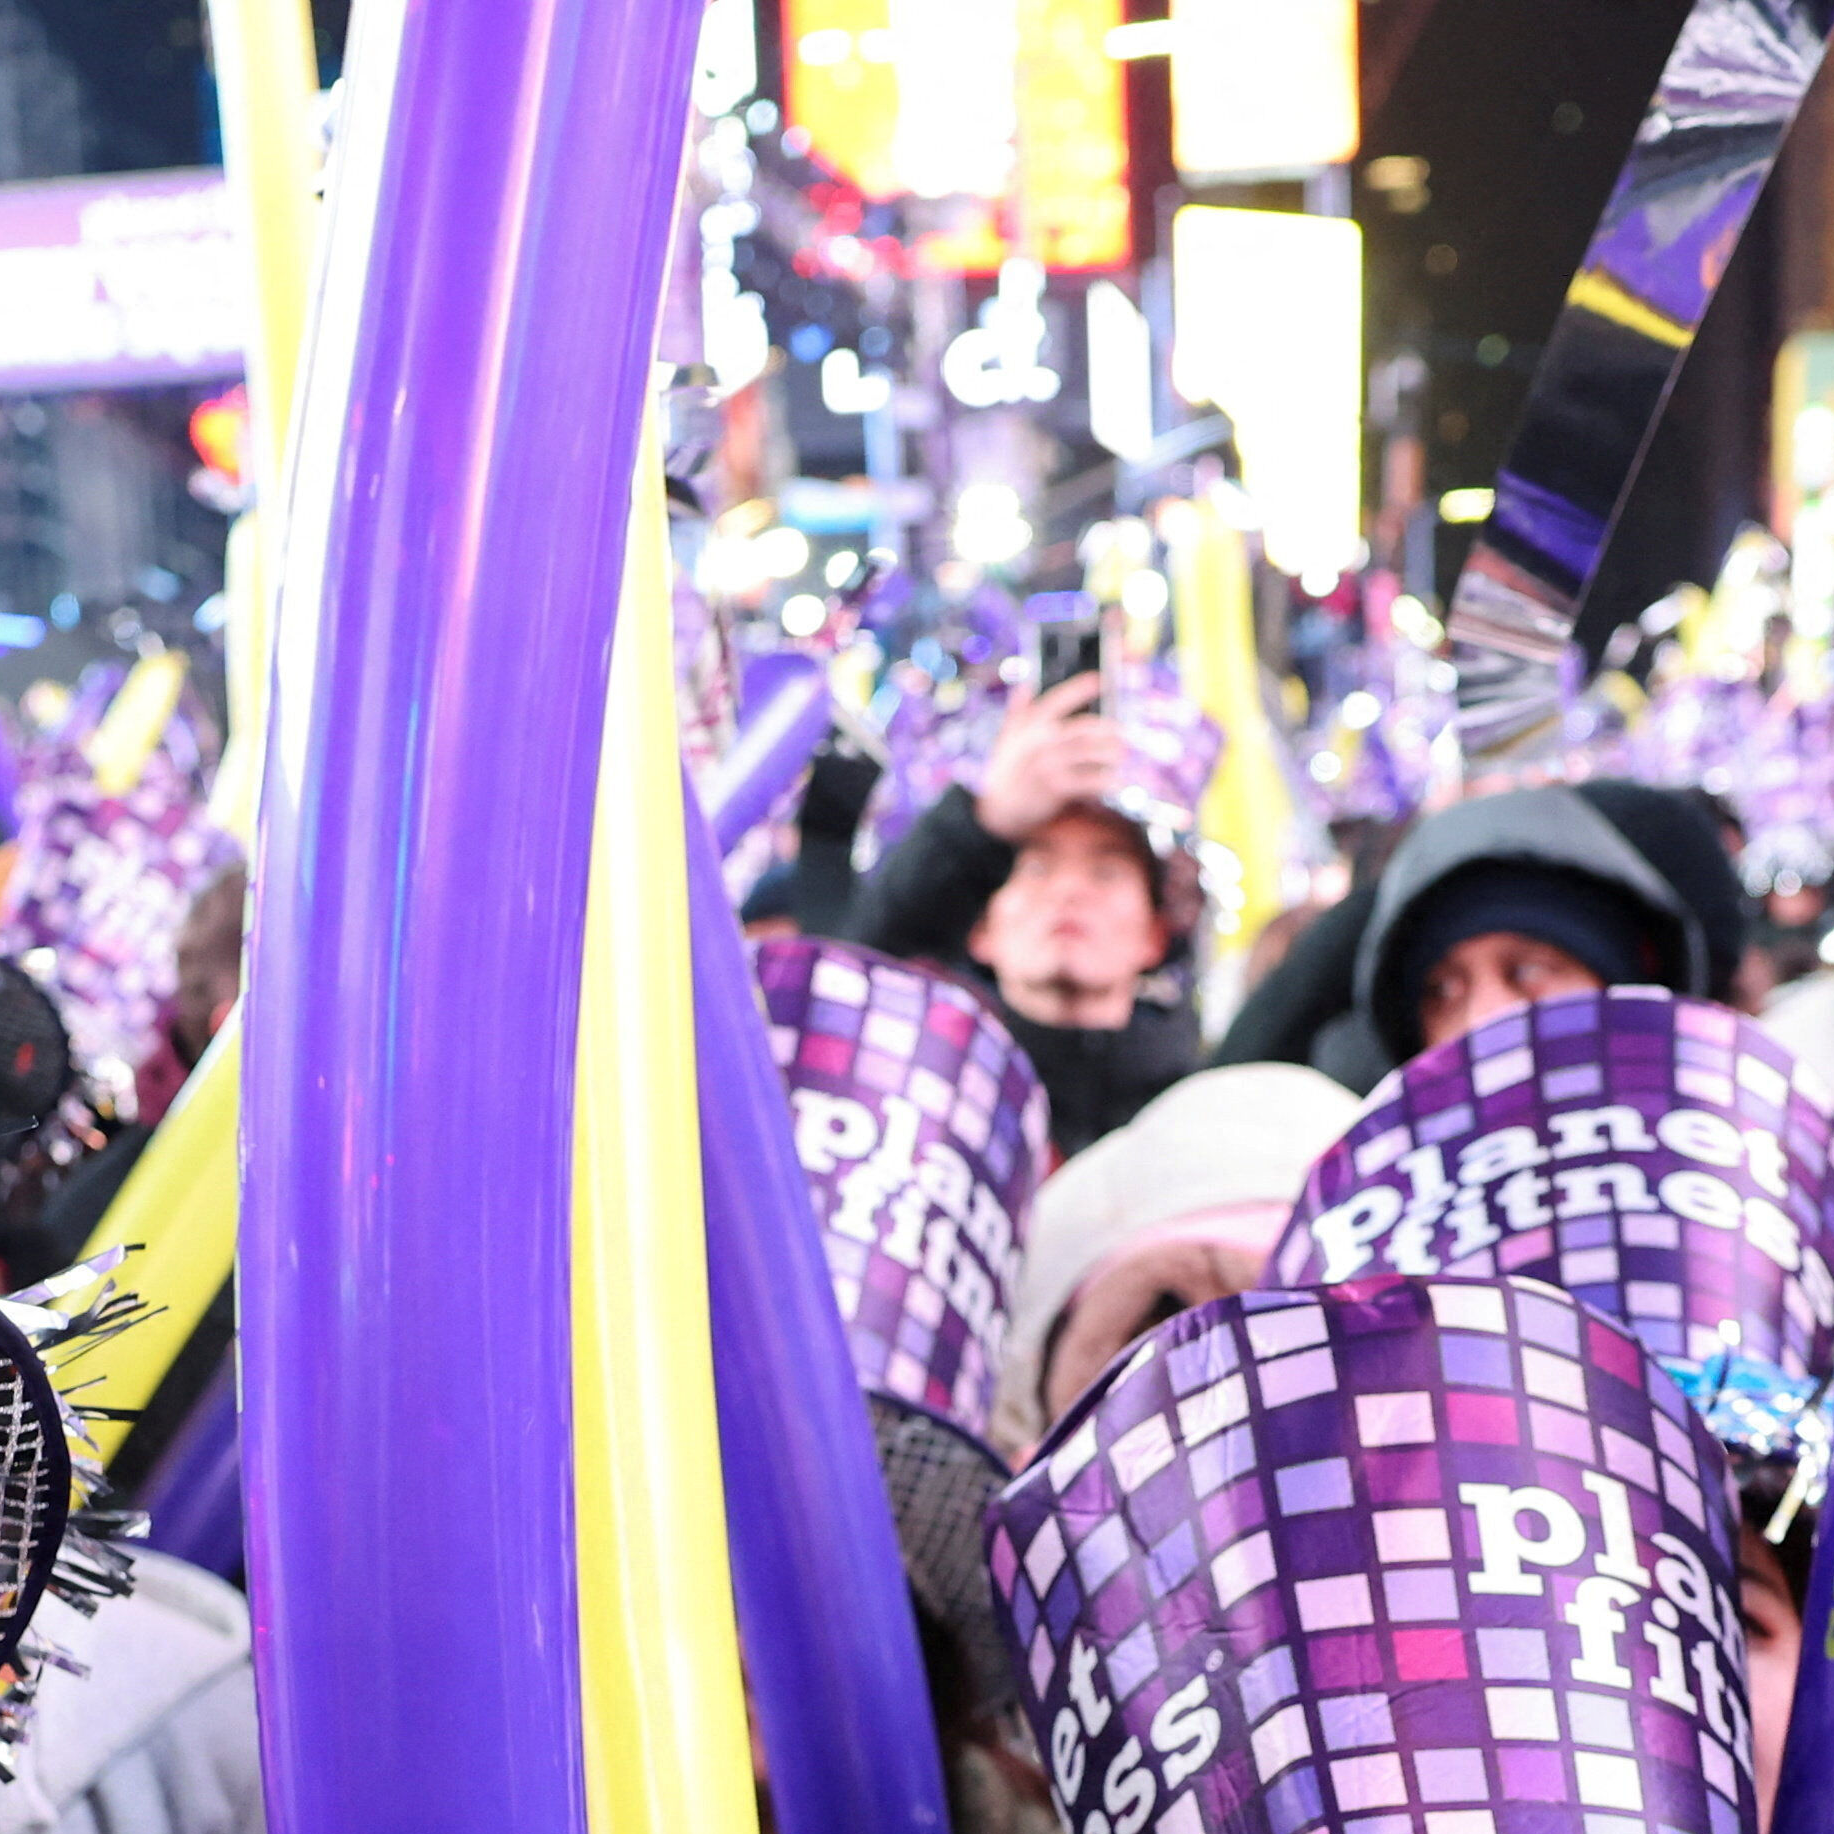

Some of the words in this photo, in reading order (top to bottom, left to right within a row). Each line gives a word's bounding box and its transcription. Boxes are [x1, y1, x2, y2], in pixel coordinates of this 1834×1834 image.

[790, 1087, 1024, 1290] plan
[829, 1160, 1005, 1345] fitn
[1312, 1103, 1789, 1283] planet
